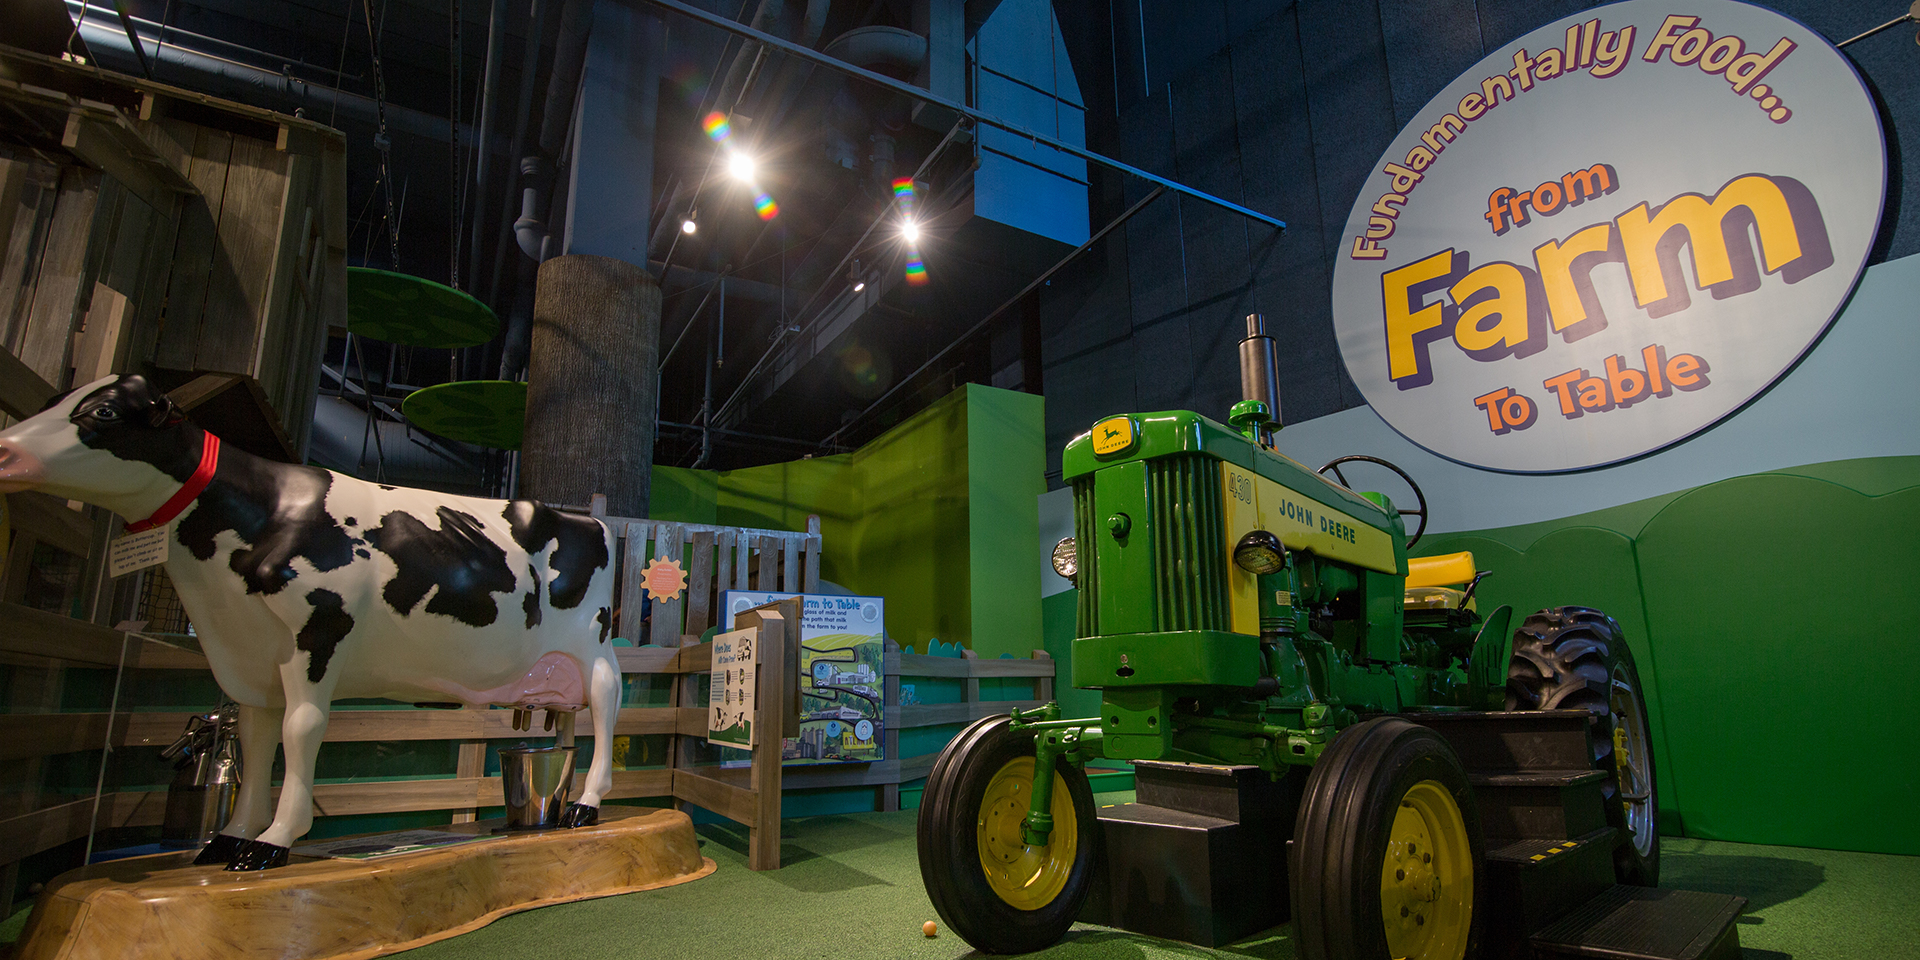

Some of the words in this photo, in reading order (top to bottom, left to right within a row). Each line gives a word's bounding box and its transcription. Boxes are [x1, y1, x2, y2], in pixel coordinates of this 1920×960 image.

[1351, 18, 1636, 260] Fundamentally
[1643, 14, 1798, 124] Food...
[1485, 163, 1616, 236] from
[1381, 173, 1822, 387] Farm
[1474, 386, 1535, 434] To
[1544, 344, 1707, 419] Table
[1229, 472, 1252, 504] 430
[1279, 499, 1313, 528] JOHN
[1320, 515, 1356, 544] DEERE
[822, 598, 834, 609] to
[835, 598, 860, 610] Table
